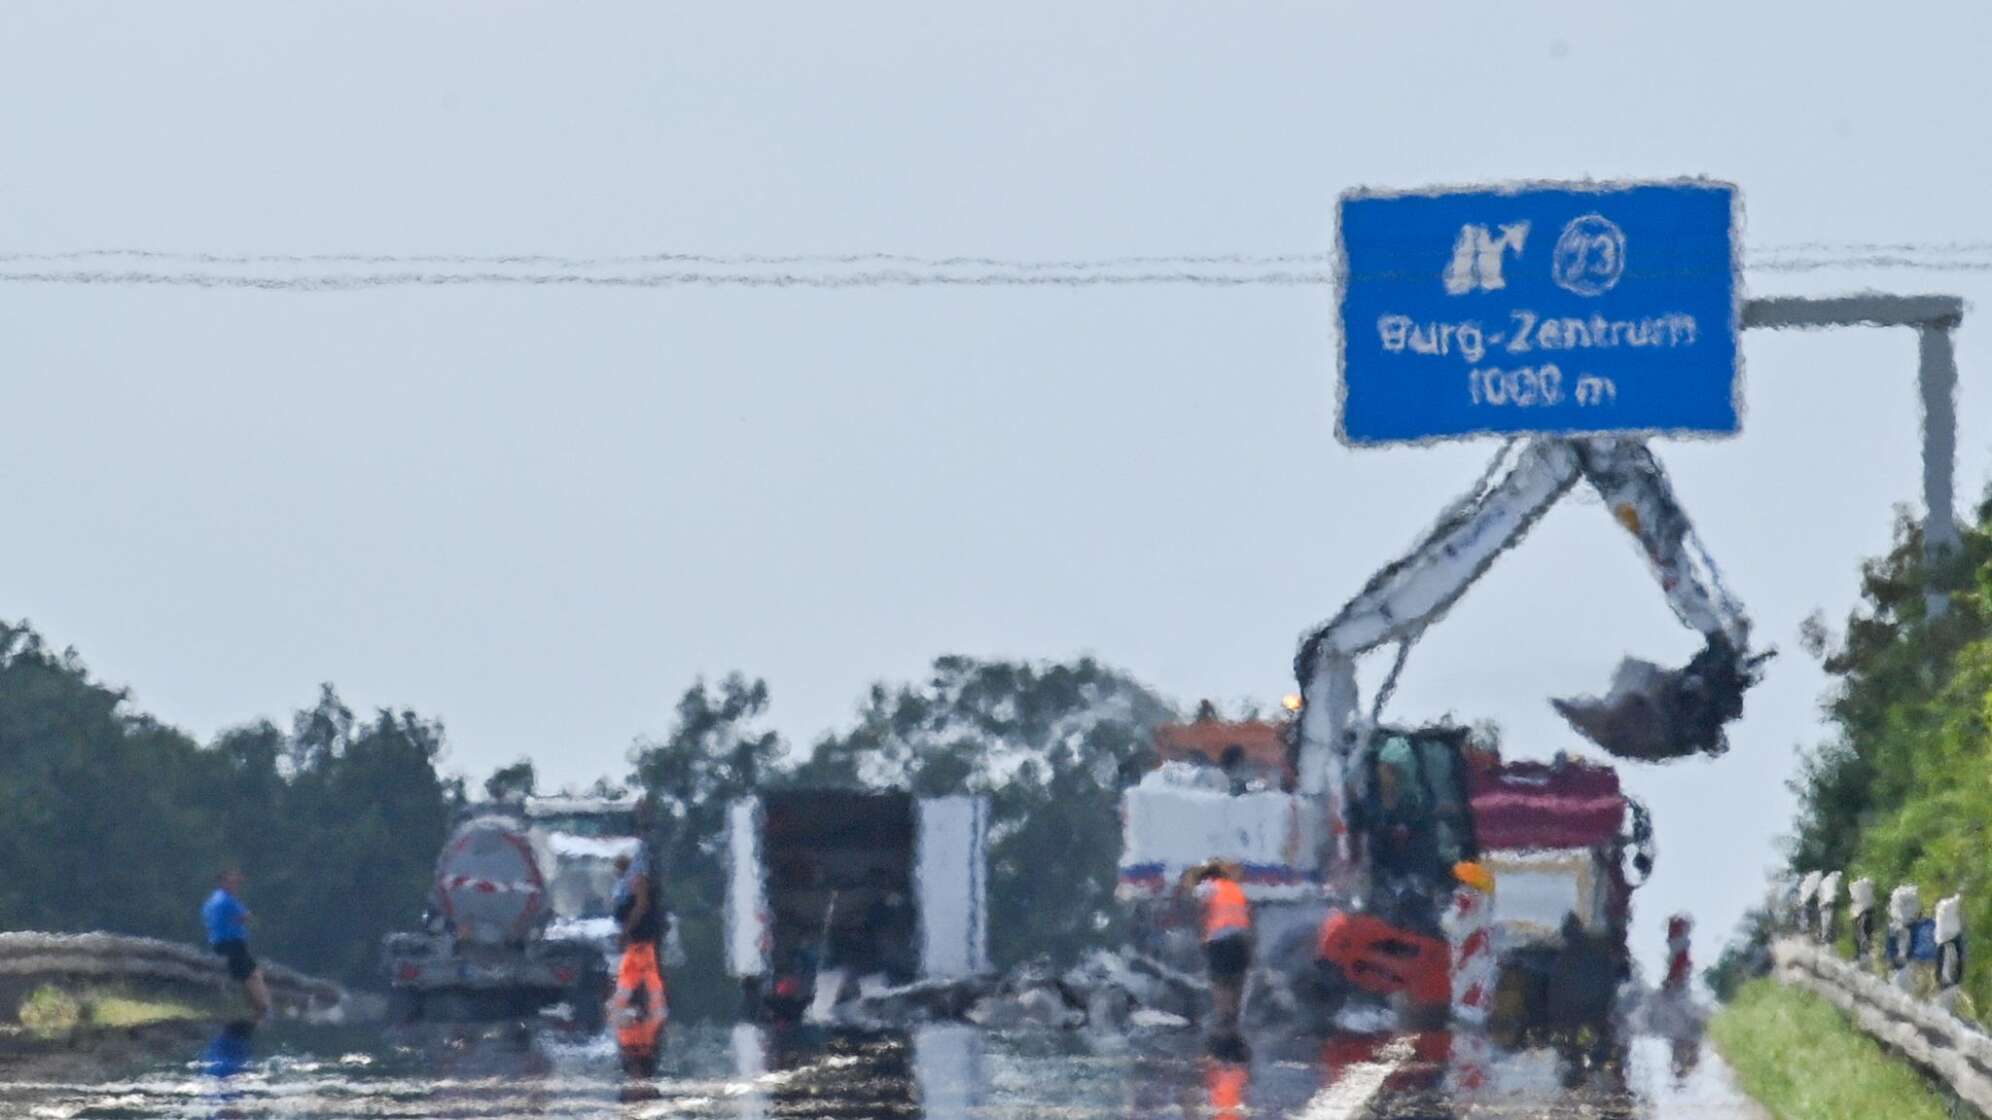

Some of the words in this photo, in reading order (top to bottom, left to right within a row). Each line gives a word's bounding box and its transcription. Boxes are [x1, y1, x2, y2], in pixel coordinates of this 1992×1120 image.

[1378, 311, 1696, 362] Burg-Zentrum
[1469, 364, 1561, 406] 1000
[1575, 374, 1616, 405] m
